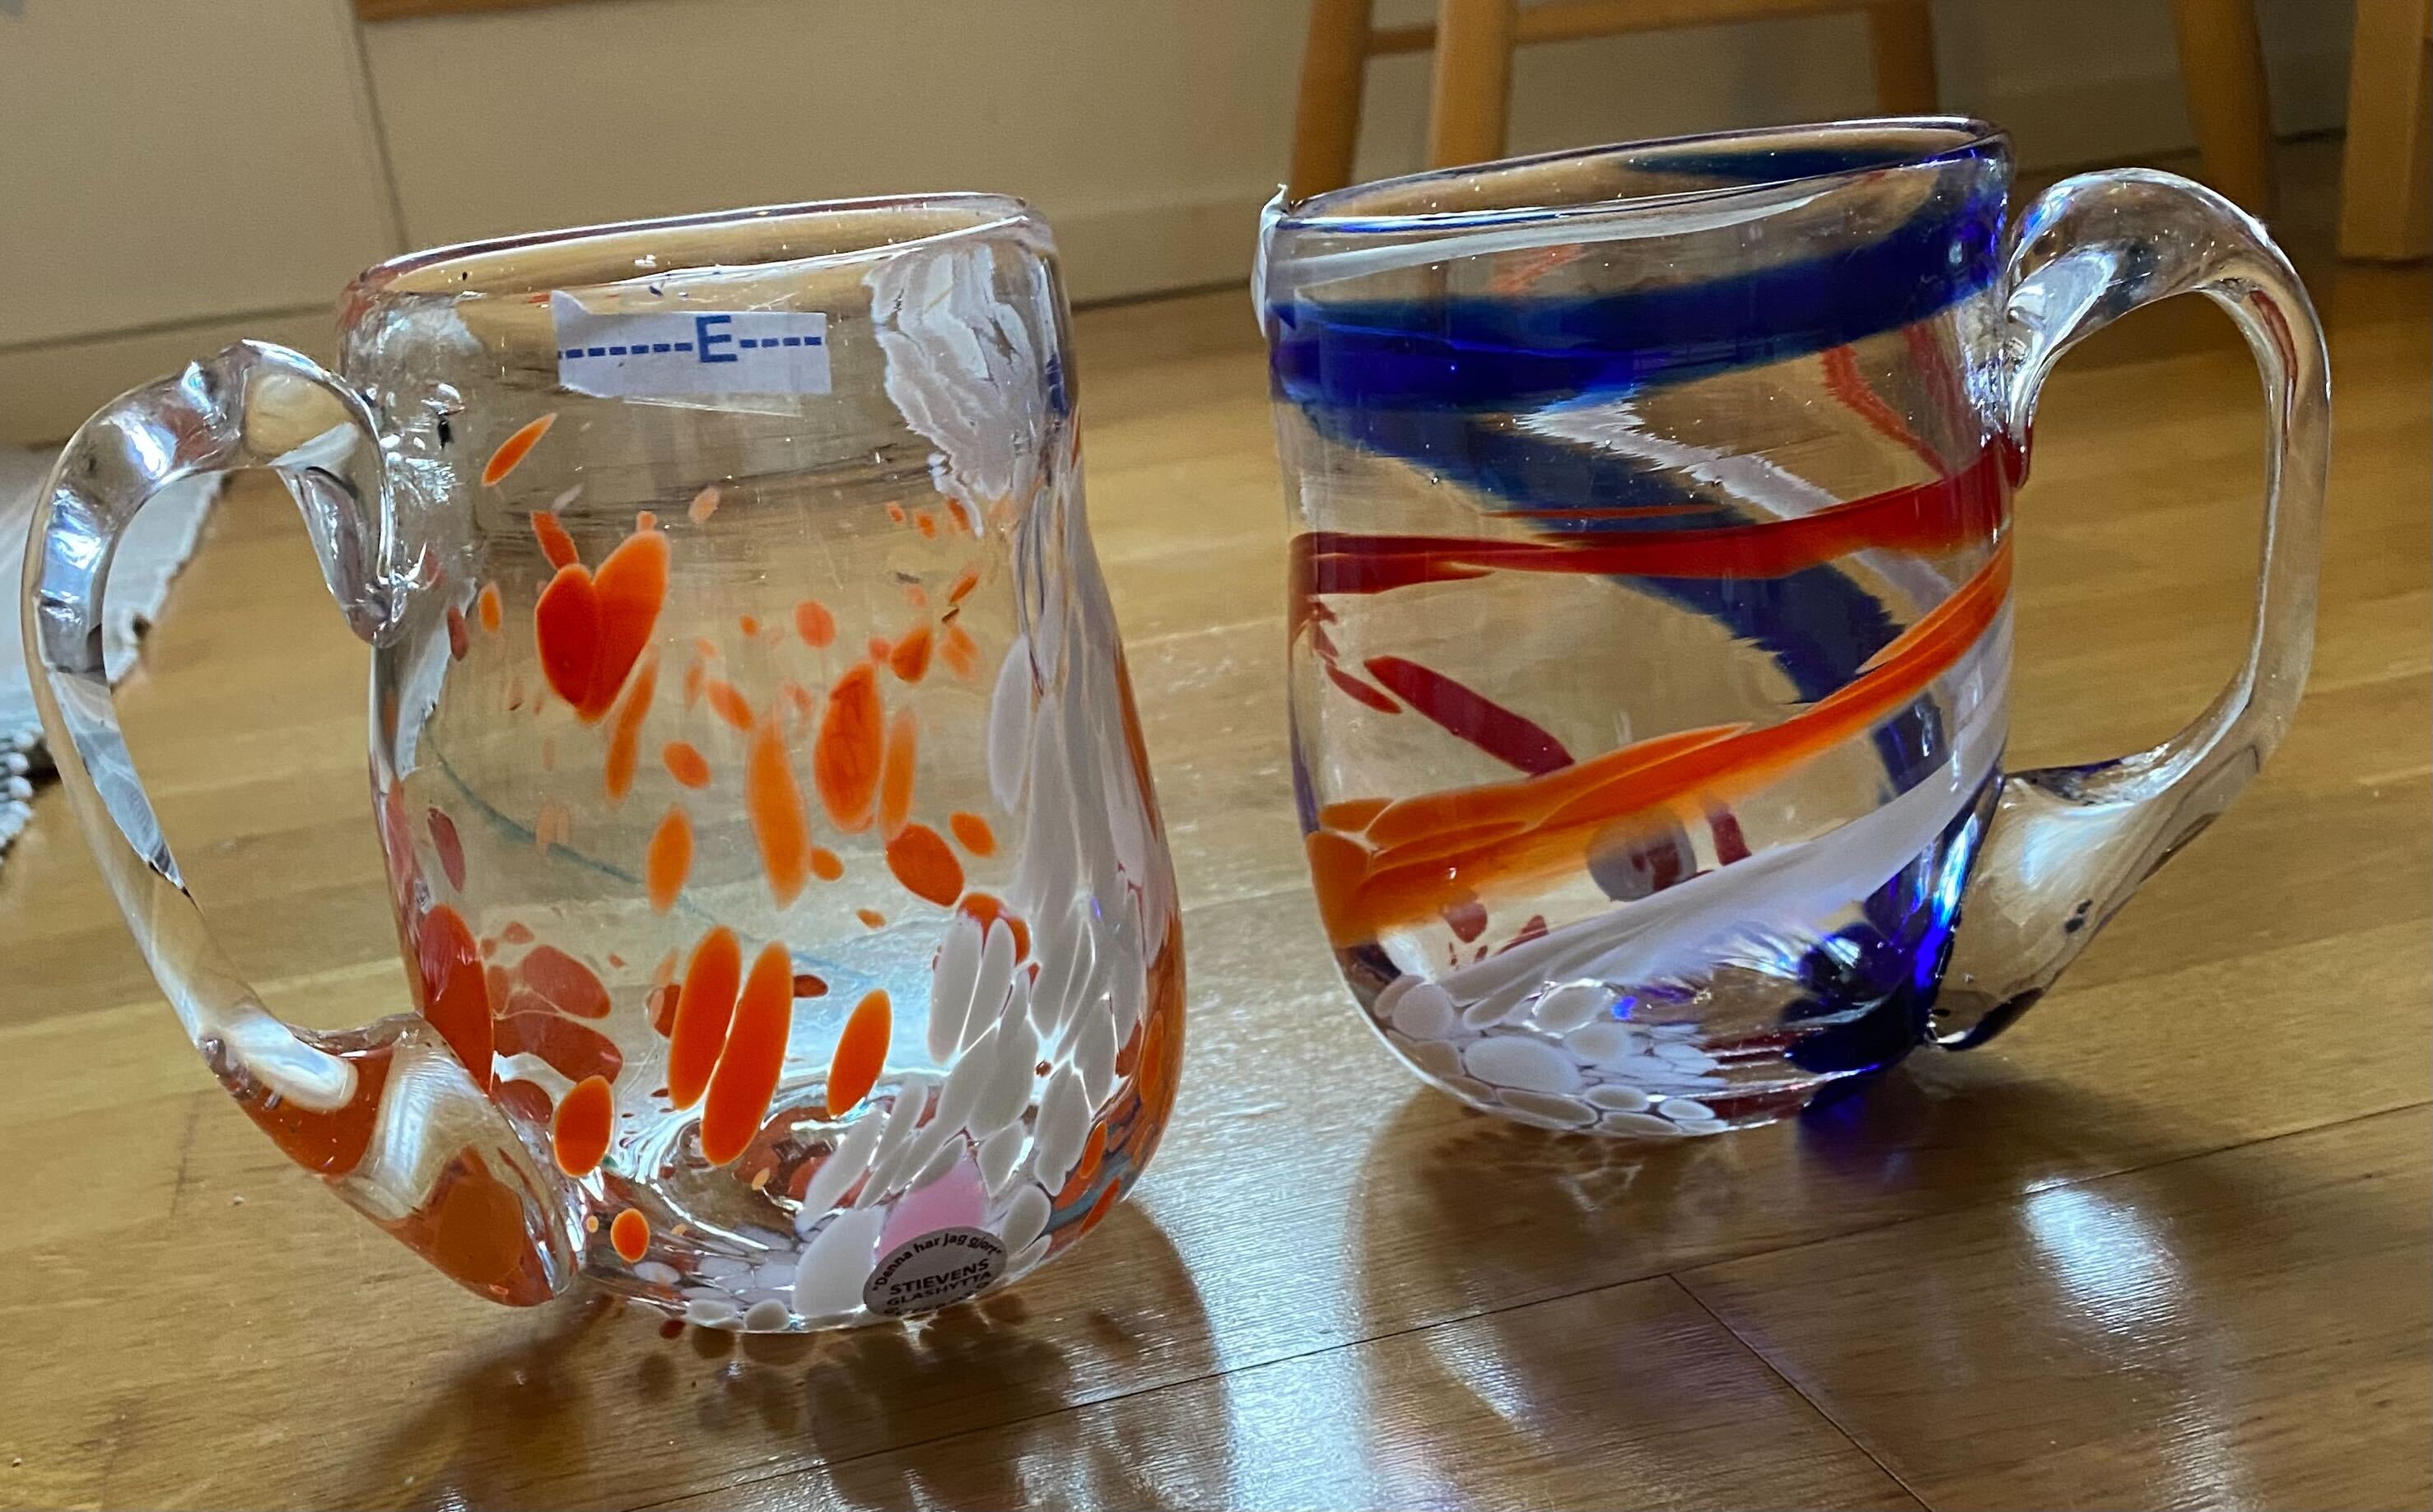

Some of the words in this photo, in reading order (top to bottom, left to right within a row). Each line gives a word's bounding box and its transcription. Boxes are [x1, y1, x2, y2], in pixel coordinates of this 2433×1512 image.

[696, 315, 739, 363] E
[914, 1237, 940, 1254] har
[886, 1271, 992, 1306] GLASHYTTA
[889, 1258, 990, 1296] STIEVENS
